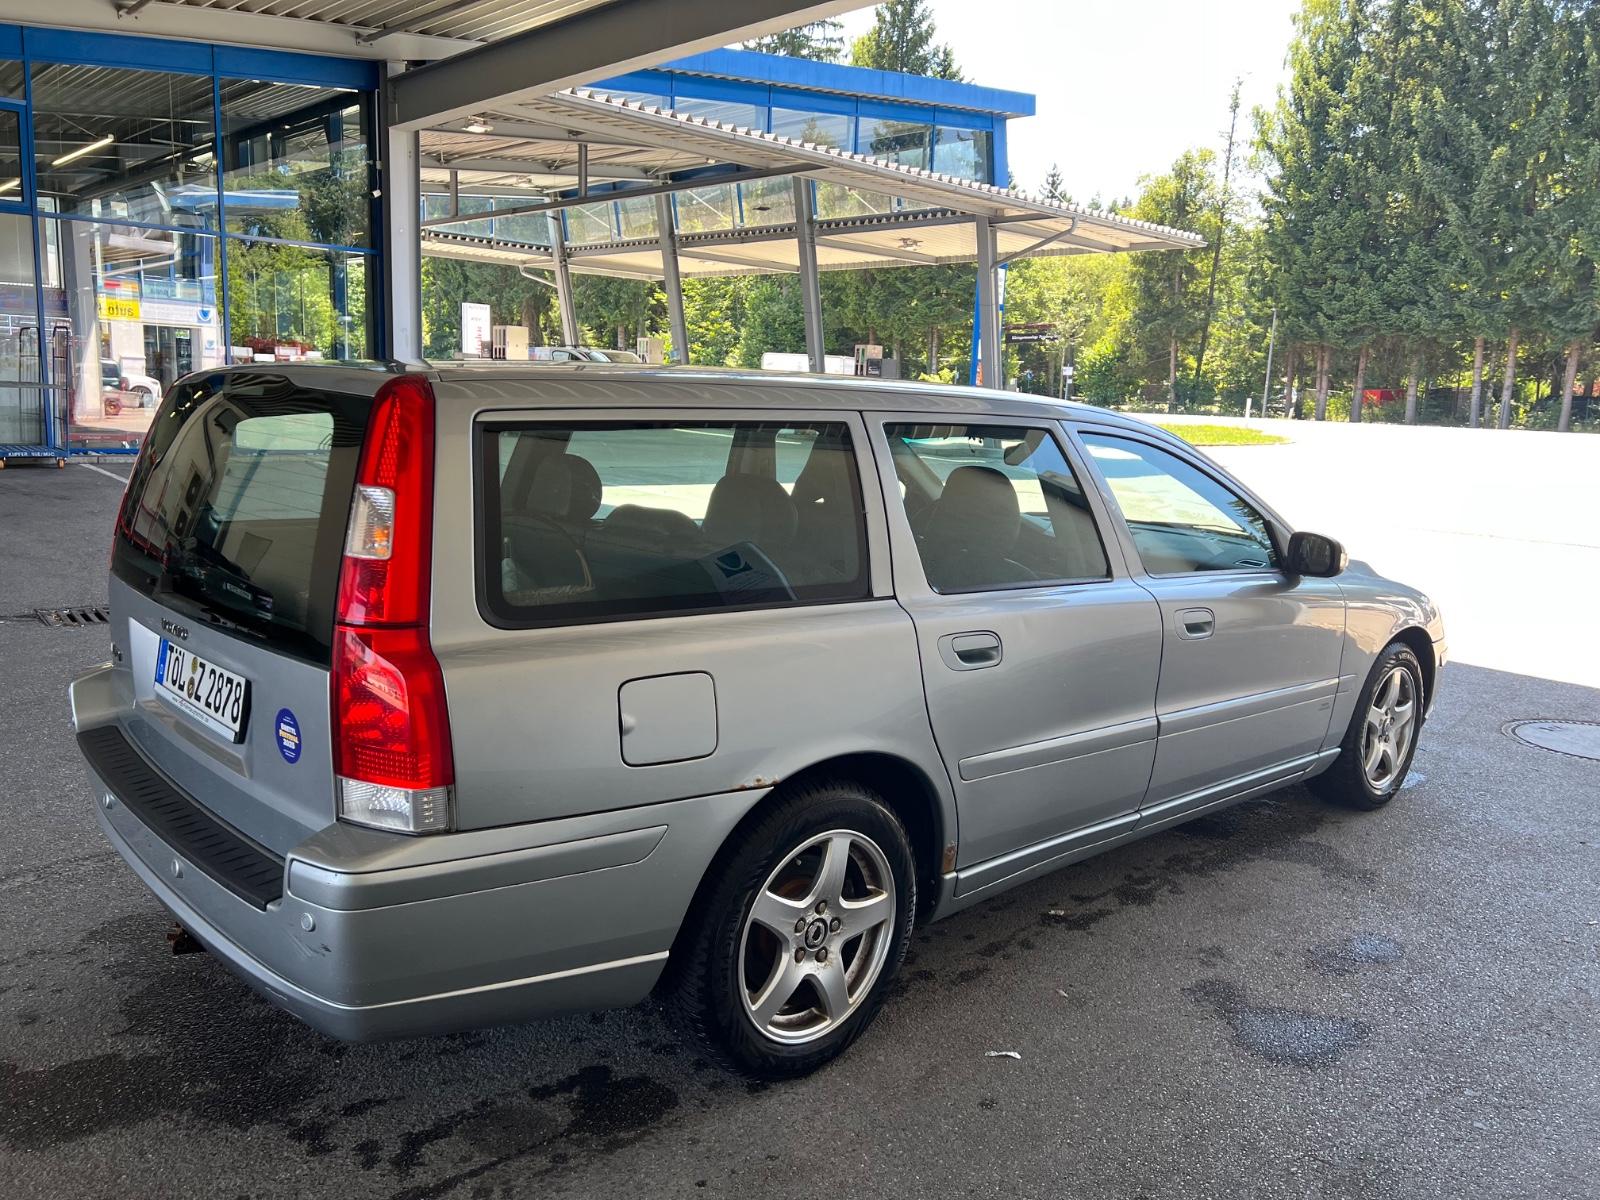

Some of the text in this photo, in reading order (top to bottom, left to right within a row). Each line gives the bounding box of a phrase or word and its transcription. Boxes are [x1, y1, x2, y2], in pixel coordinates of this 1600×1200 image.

[166, 644, 186, 692] TÖL
[194, 661, 206, 702] Z
[204, 668, 242, 724] 2878
